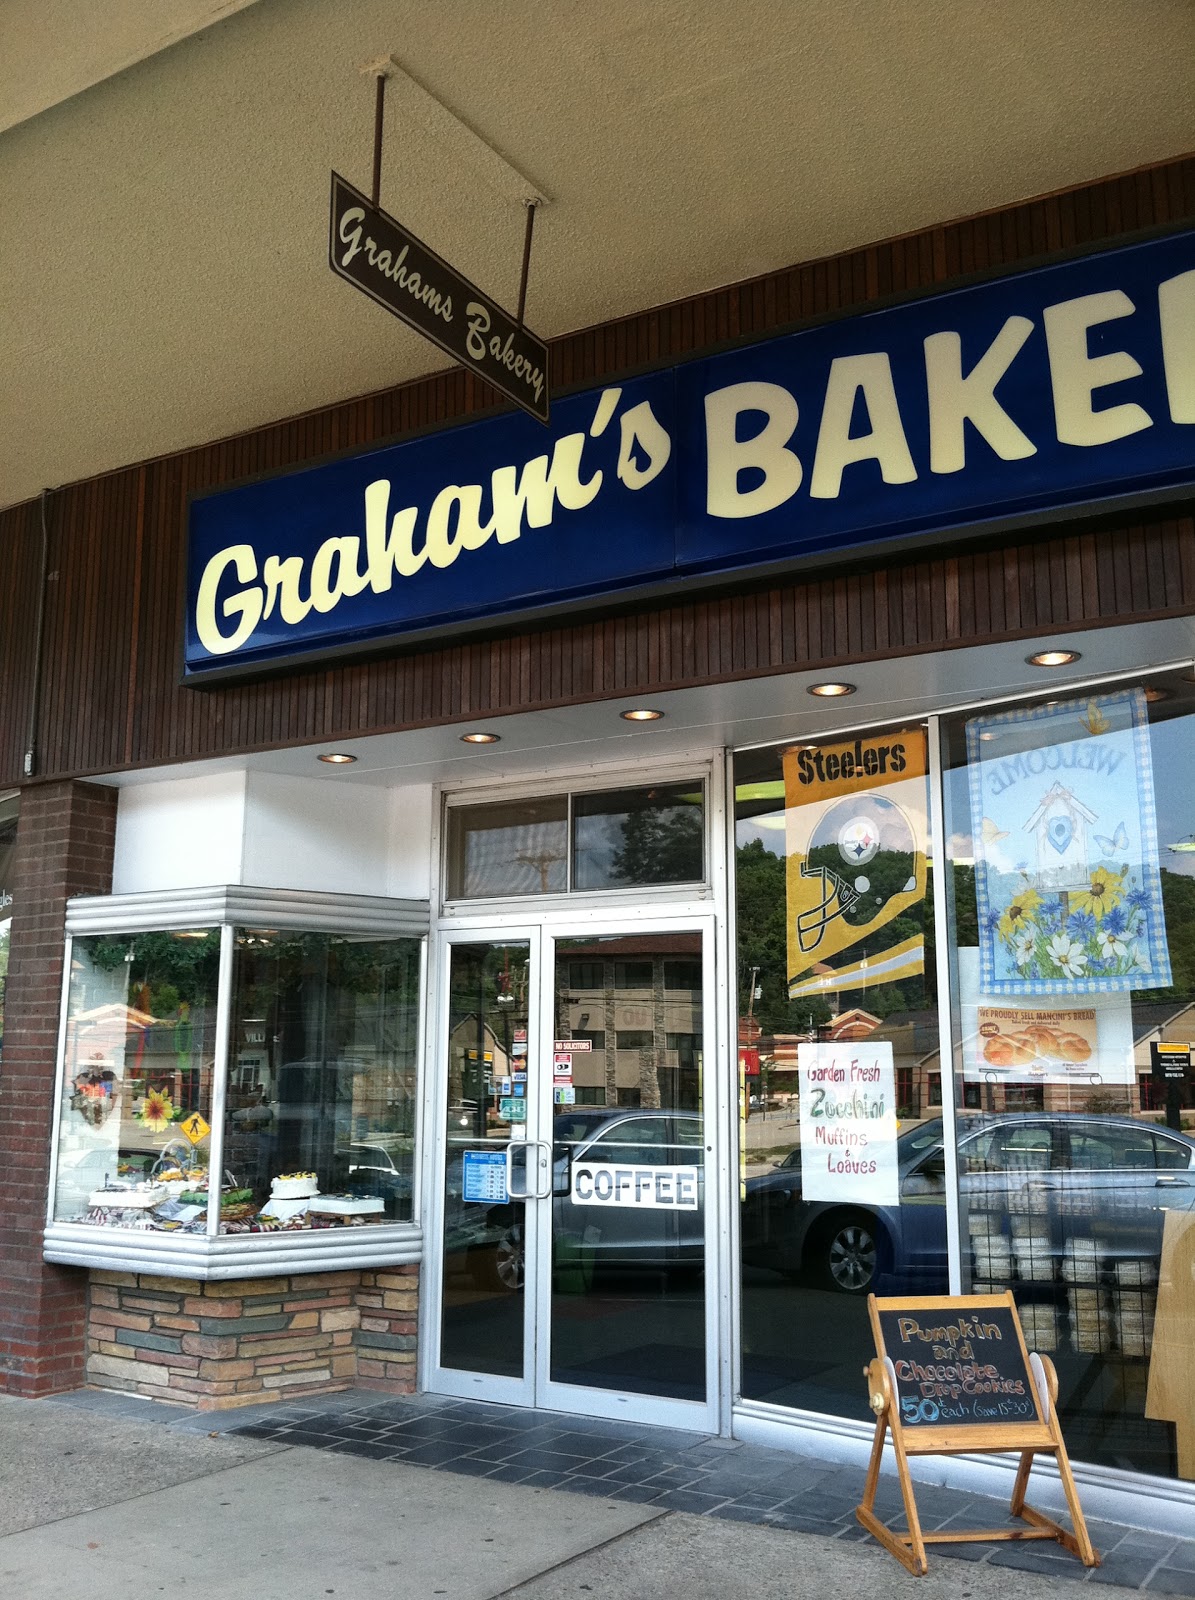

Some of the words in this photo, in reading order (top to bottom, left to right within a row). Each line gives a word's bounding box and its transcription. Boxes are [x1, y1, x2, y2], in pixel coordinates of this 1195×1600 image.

[339, 206, 454, 323] Grahams
[465, 301, 545, 404] Bakery
[195, 387, 672, 655] Graham's
[797, 740, 907, 785] Steelers
[979, 1008, 989, 1018] WE
[990, 1010, 1019, 1020] PROUDLY
[1020, 1011, 1035, 1021] SELL
[1036, 1011, 1072, 1021] MANCINI'S
[1073, 1010, 1096, 1021] BREAD
[555, 1042, 563, 1050] NO
[563, 1042, 590, 1050] SOLICITORS
[807, 1059, 845, 1083] Garden
[850, 1058, 881, 1083] Fresh
[809, 1086, 885, 1120] Zucchini
[815, 1125, 869, 1147] Muffins
[827, 1152, 878, 1175] Loaves
[844, 1149, 851, 1157] &
[575, 1168, 697, 1206] COFFEE
[897, 1315, 1003, 1348] Pumpkin
[931, 1340, 976, 1361] and
[894, 1359, 1000, 1382] Chocolate
[919, 1381, 962, 1400] Drop
[961, 1375, 1026, 1395] Cookies
[941, 1401, 970, 1419] each
